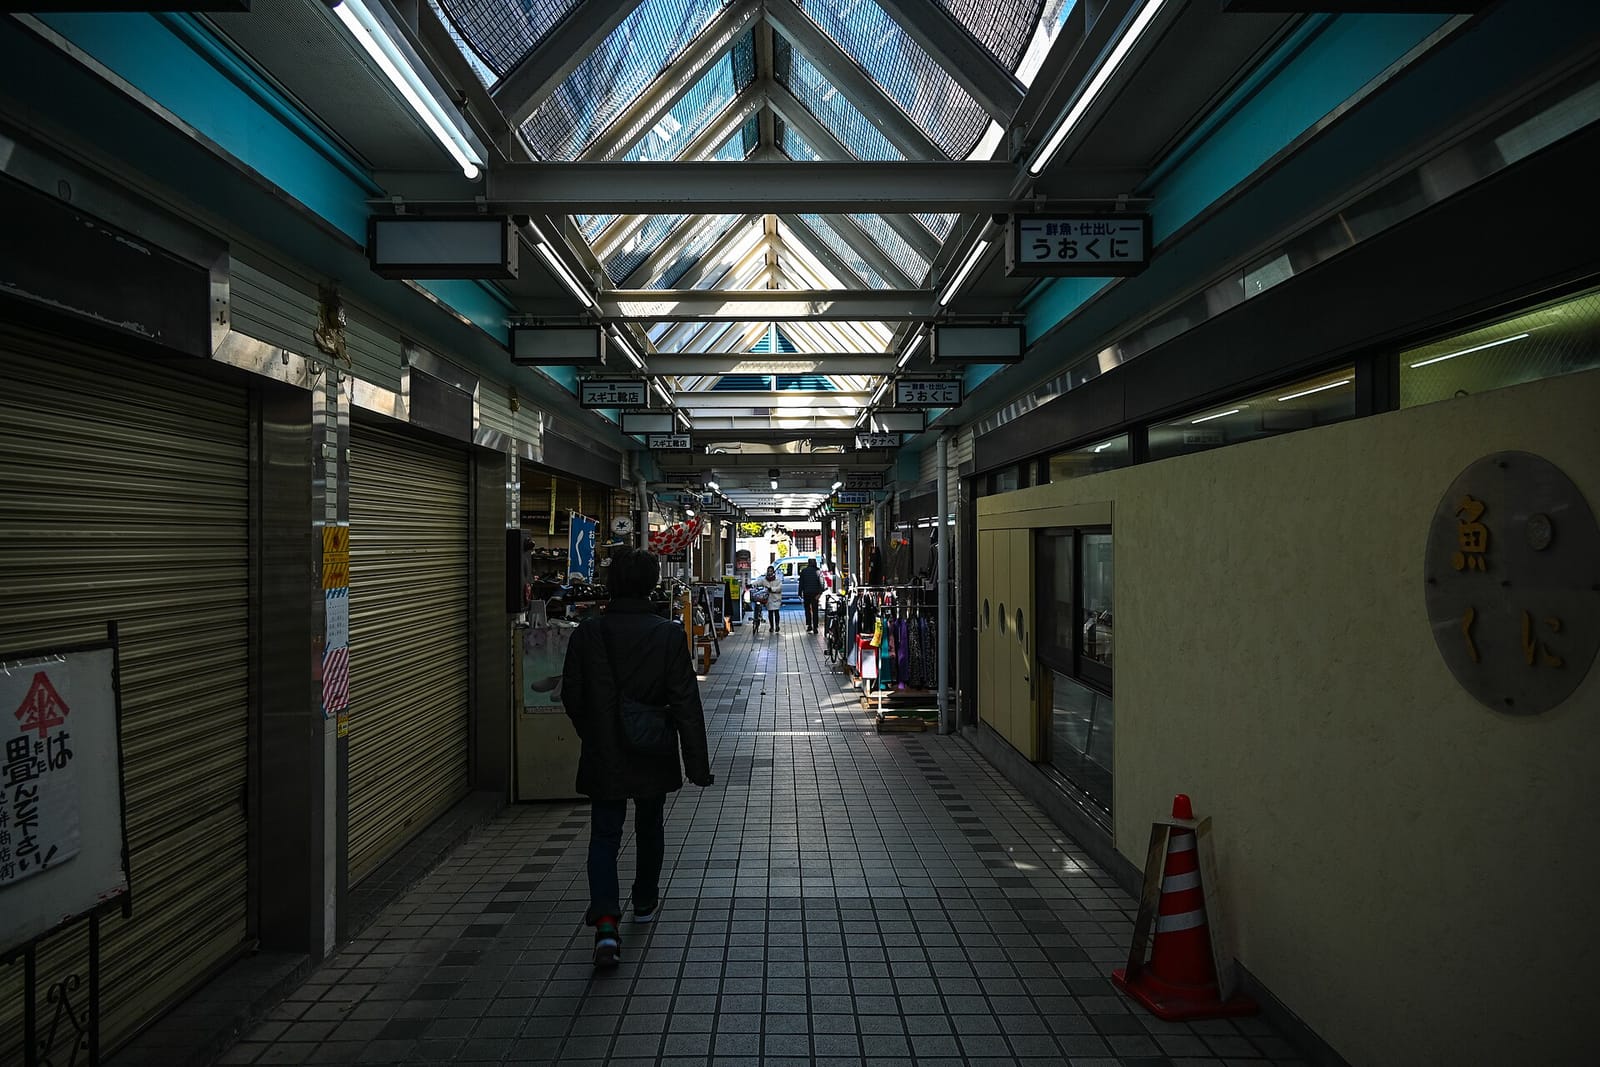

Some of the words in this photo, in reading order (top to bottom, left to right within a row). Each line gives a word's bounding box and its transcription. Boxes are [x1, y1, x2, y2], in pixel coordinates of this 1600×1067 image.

[1046, 222, 1116, 236] 鮮魚・仕出し
[1032, 238, 1129, 259] うおくに
[905, 391, 953, 402] うおくに
[1452, 495, 1490, 572] 魚
[1461, 606, 1567, 669] くに
